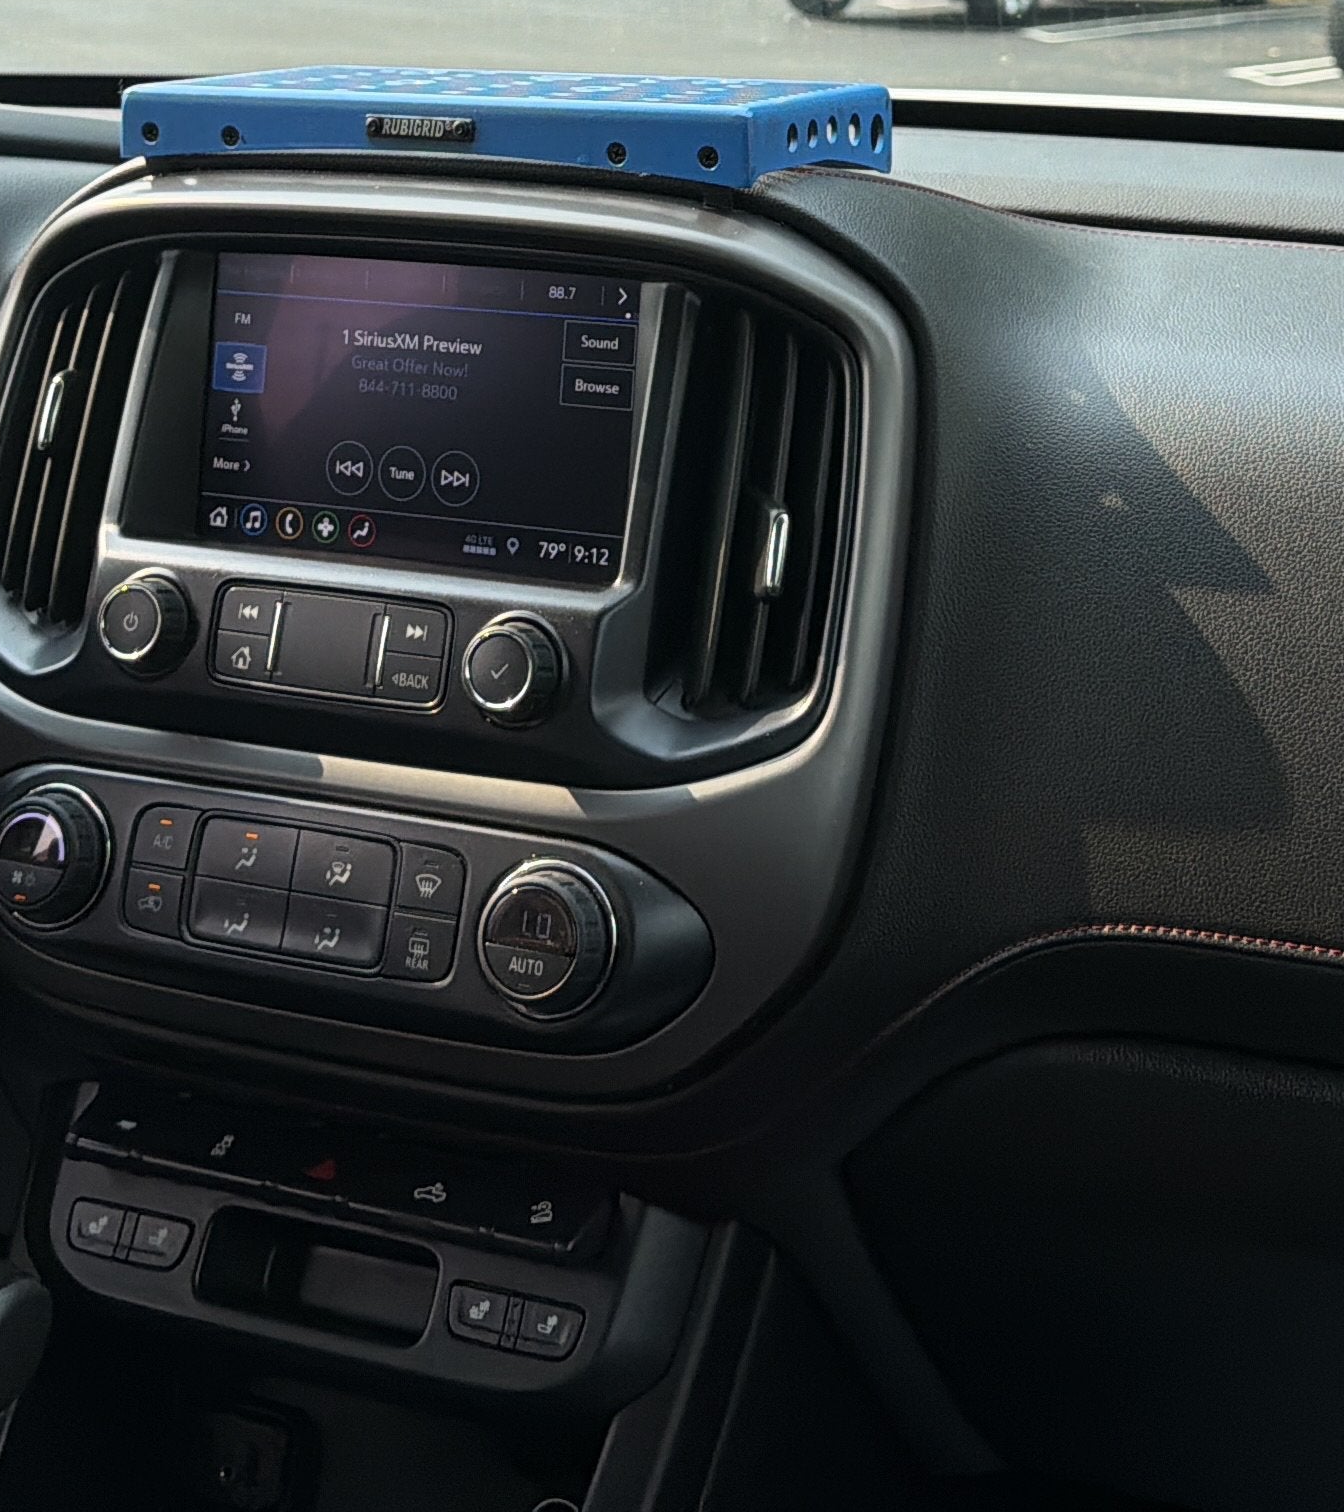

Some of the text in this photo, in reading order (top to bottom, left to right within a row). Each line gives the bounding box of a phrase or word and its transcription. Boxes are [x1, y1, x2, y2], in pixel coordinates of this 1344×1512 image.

[548, 286, 577, 300] 88.7
[234, 312, 251, 325] FM
[342, 329, 482, 356] 1 SiriusXM Preview
[580, 334, 619, 351] Sound
[351, 355, 468, 378] Great Offer Now!
[358, 378, 458, 401] 844-711-8800
[574, 379, 620, 396] Browse
[221, 423, 249, 436] iPhone
[213, 458, 240, 472] More
[390, 466, 415, 482] Tune
[478, 535, 493, 545] LTE
[538, 541, 609, 566] 79° 9:12
[398, 671, 430, 690] BACK
[152, 831, 174, 851] A/C
[405, 955, 430, 972] REAR
[509, 956, 544, 976] AUTO
